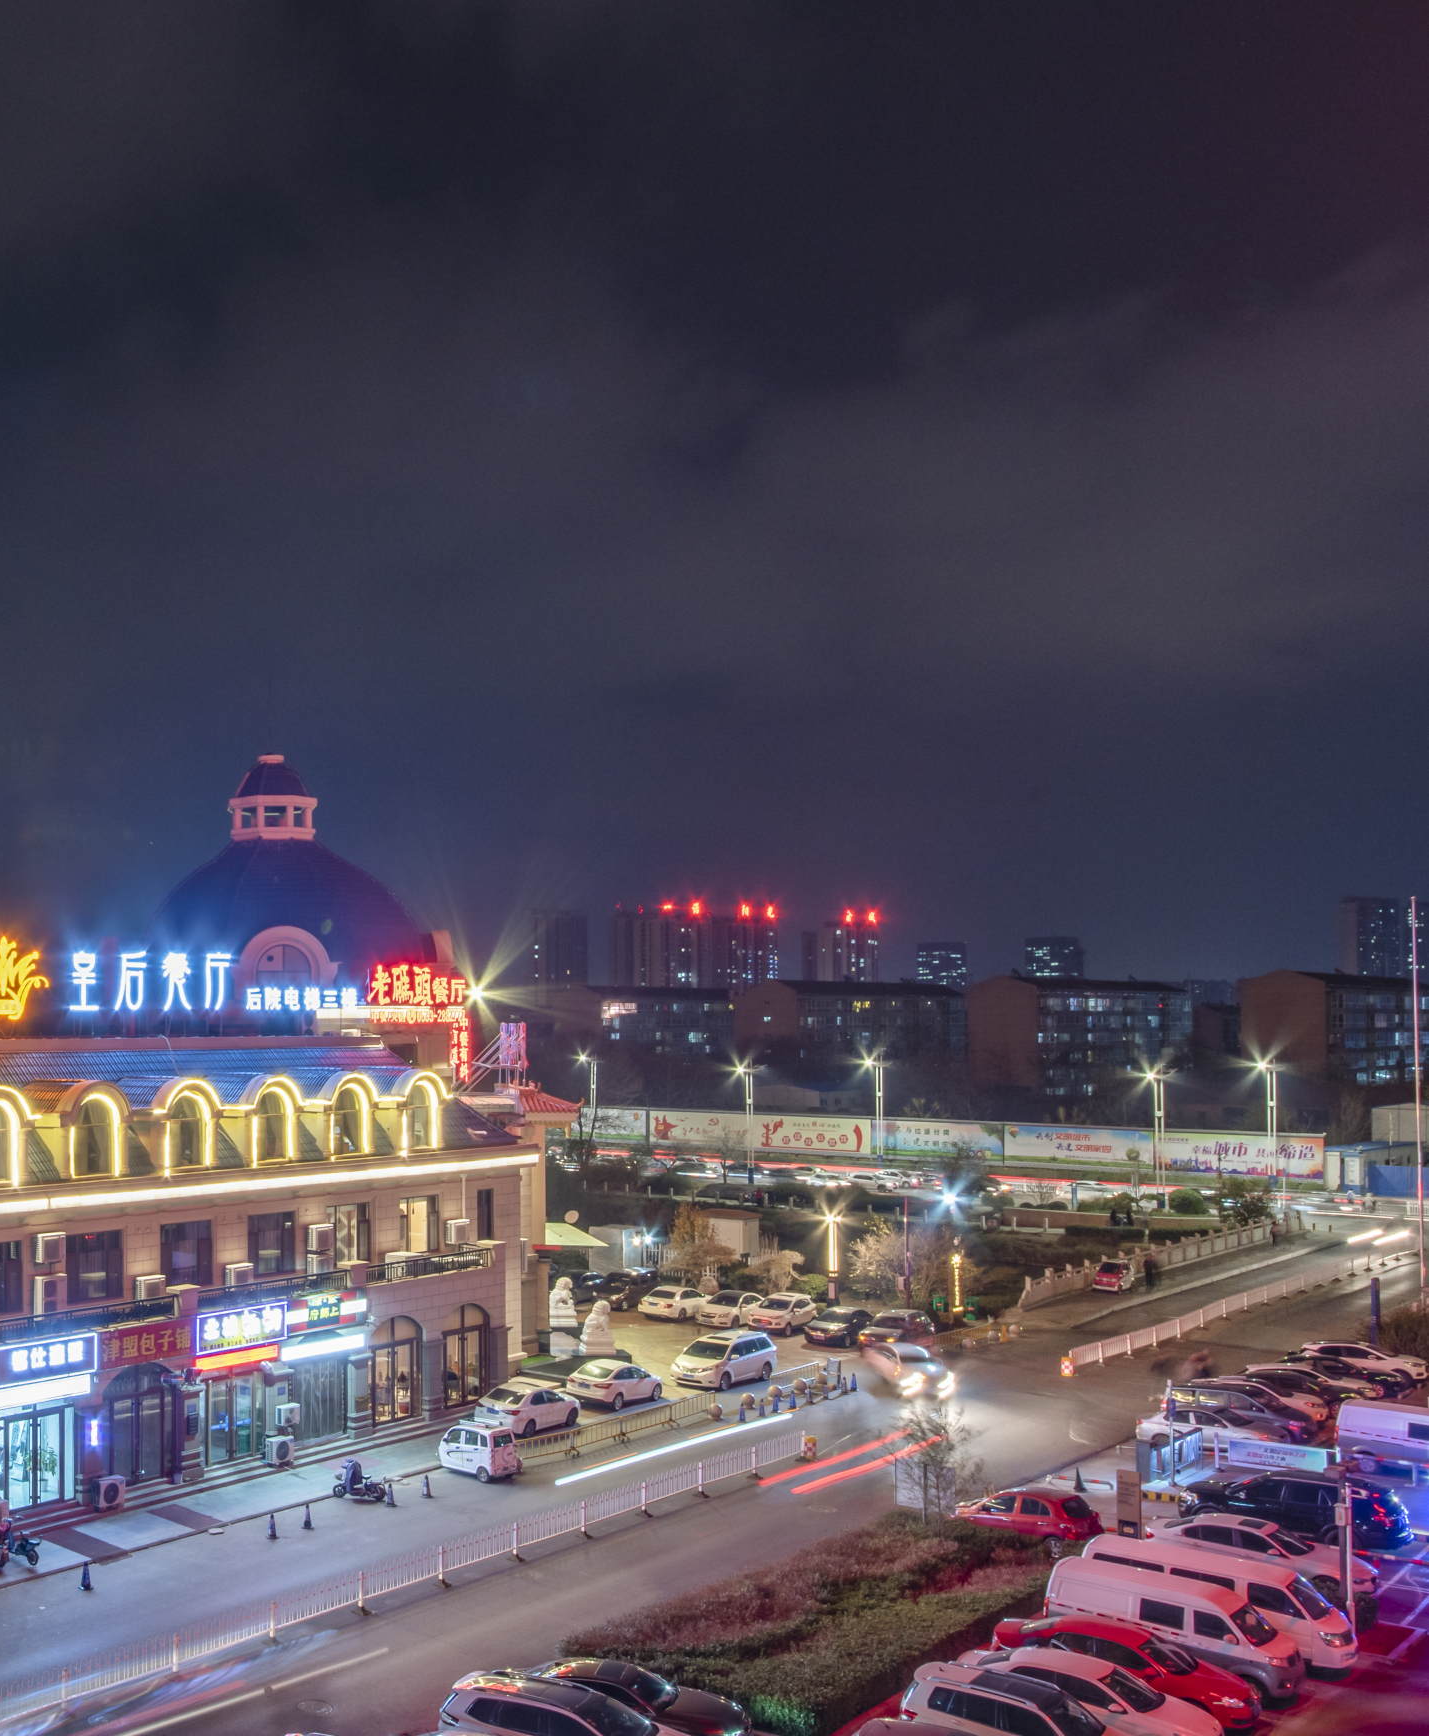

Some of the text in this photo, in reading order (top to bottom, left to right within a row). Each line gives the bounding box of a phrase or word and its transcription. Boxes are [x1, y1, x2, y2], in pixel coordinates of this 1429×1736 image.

[69, 951, 232, 1011] 皇后餐厅
[245, 987, 358, 1011] 后院电梯三楼
[458, 1018, 469, 1083] 中餐有料
[1035, 1131, 1091, 1142] 共创文明城市
[1055, 1142, 1112, 1154] 共建文明家园
[102, 1325, 192, 1364] 津盟包子铺
